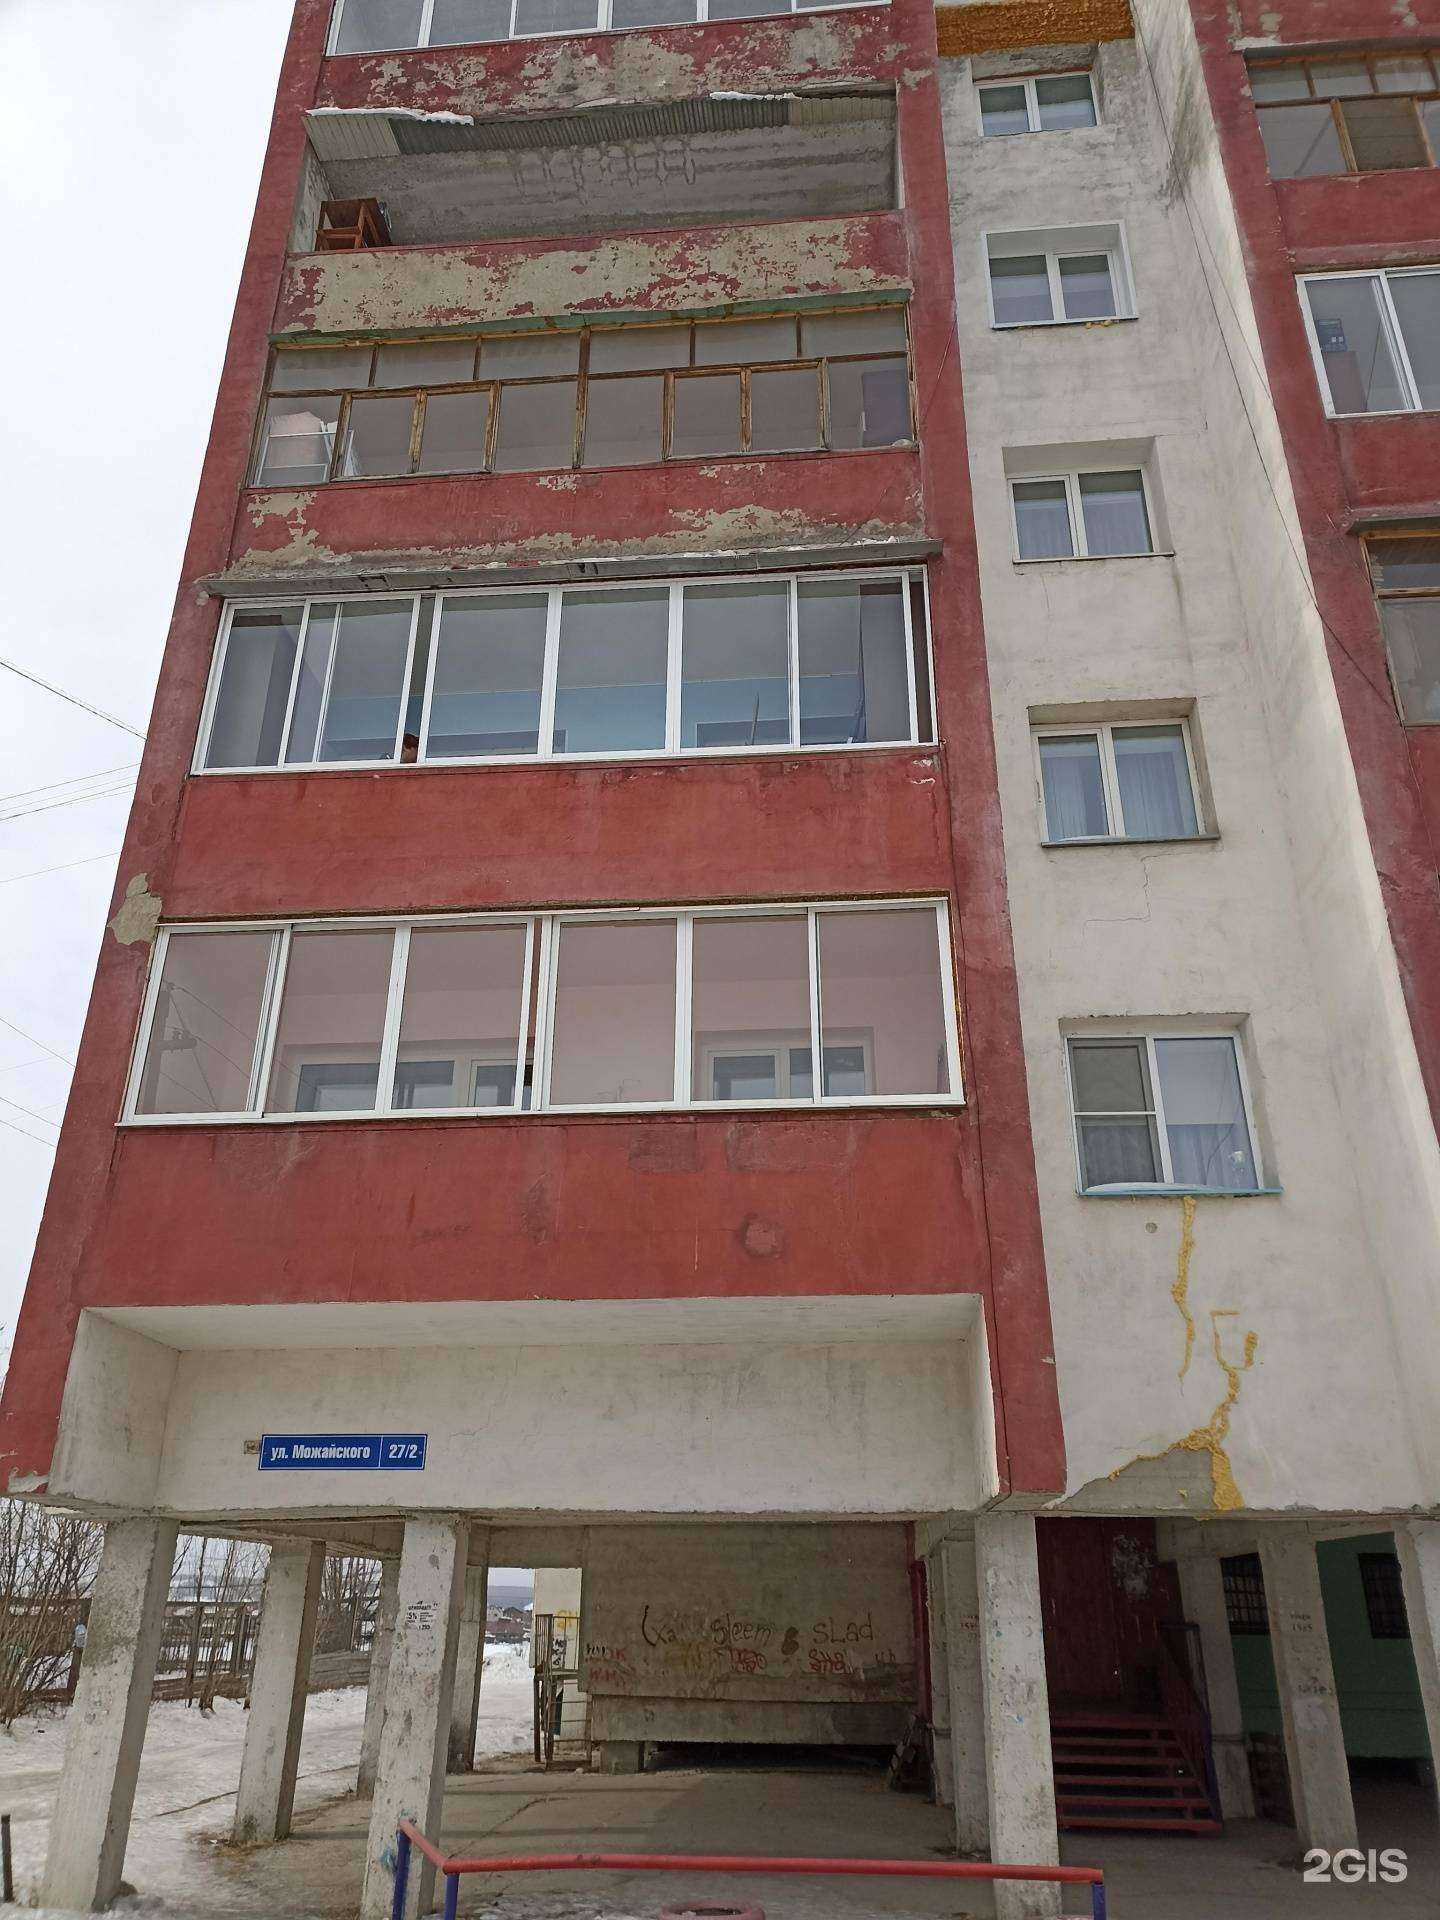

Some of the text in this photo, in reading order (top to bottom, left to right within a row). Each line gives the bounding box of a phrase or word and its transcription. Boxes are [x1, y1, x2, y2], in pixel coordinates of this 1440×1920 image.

[270, 1443, 371, 1461] ул. Можайского
[388, 1444, 418, 1459] 27/2
